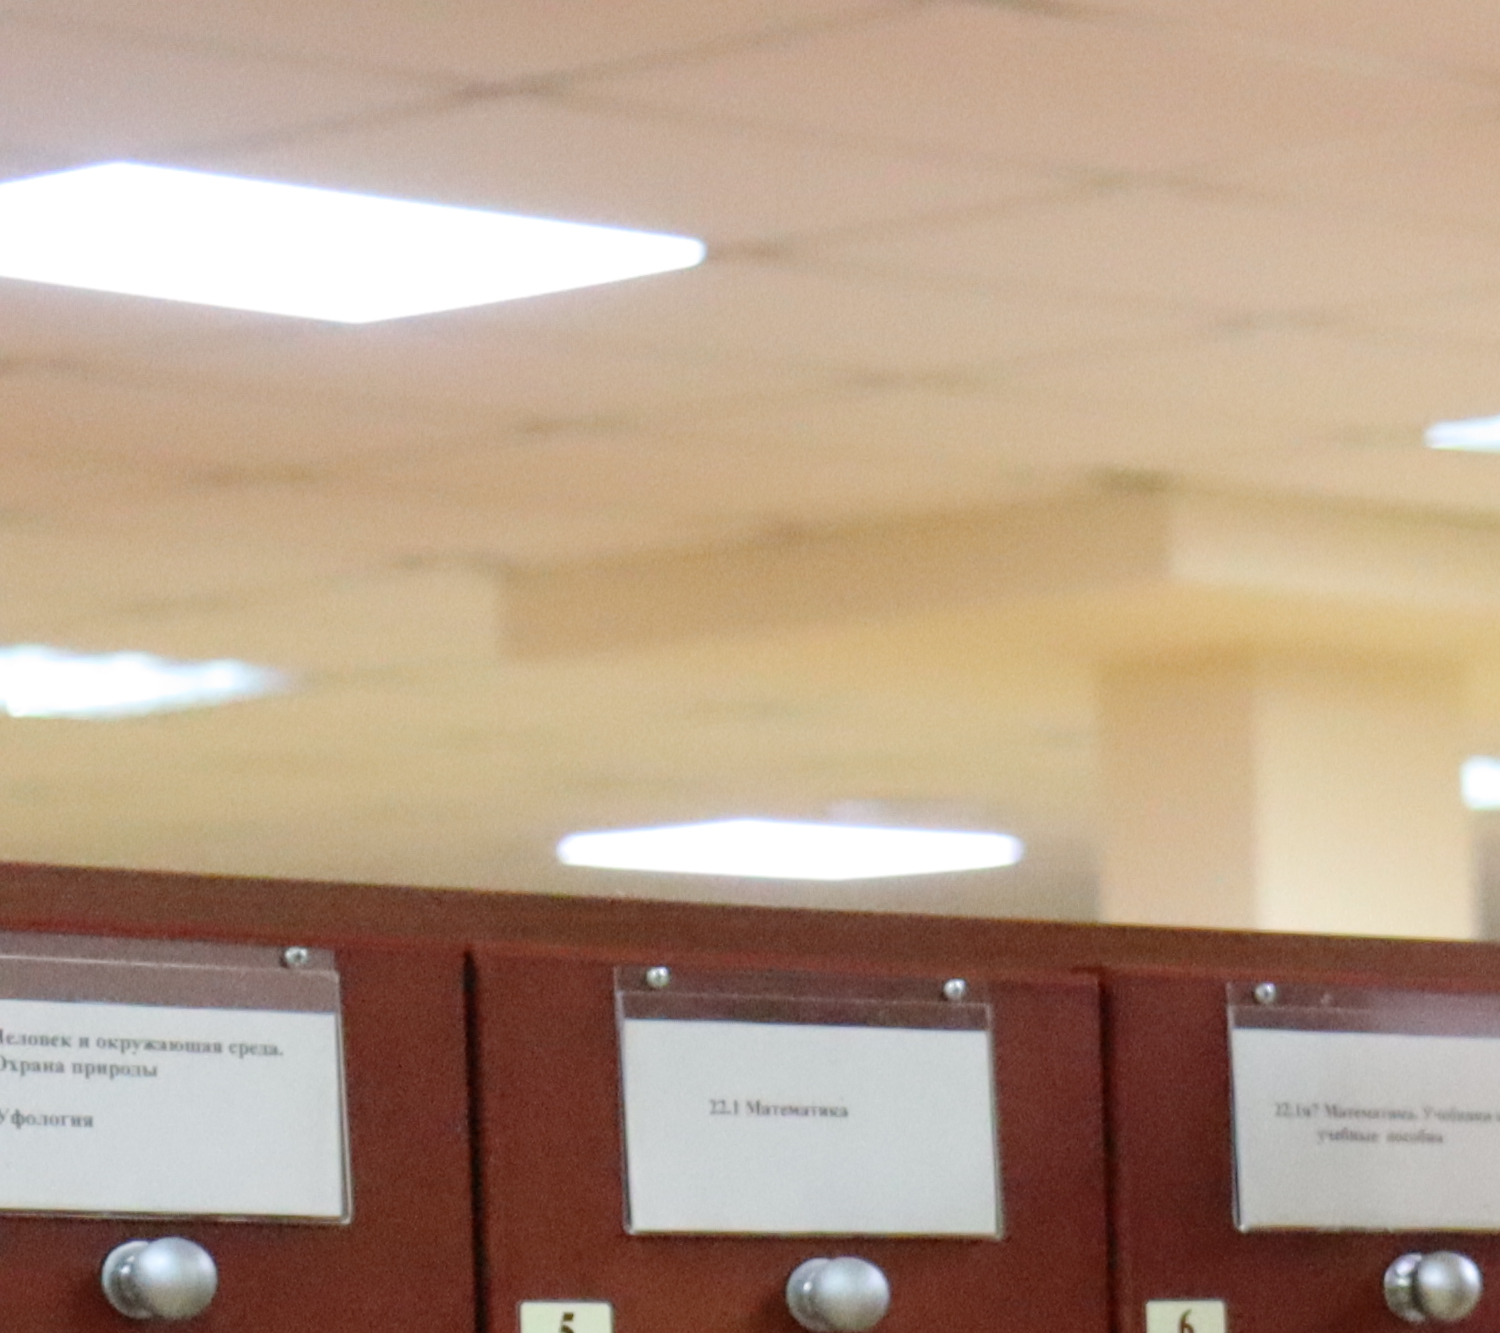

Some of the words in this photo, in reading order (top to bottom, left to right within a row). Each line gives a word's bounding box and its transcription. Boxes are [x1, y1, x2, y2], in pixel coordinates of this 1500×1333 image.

[78, 1036, 90, 1049] и
[95, 1036, 224, 1055] окружающая
[227, 1042, 284, 1060] среда.
[71, 1062, 158, 1081] природы
[745, 1099, 850, 1119] Математика
